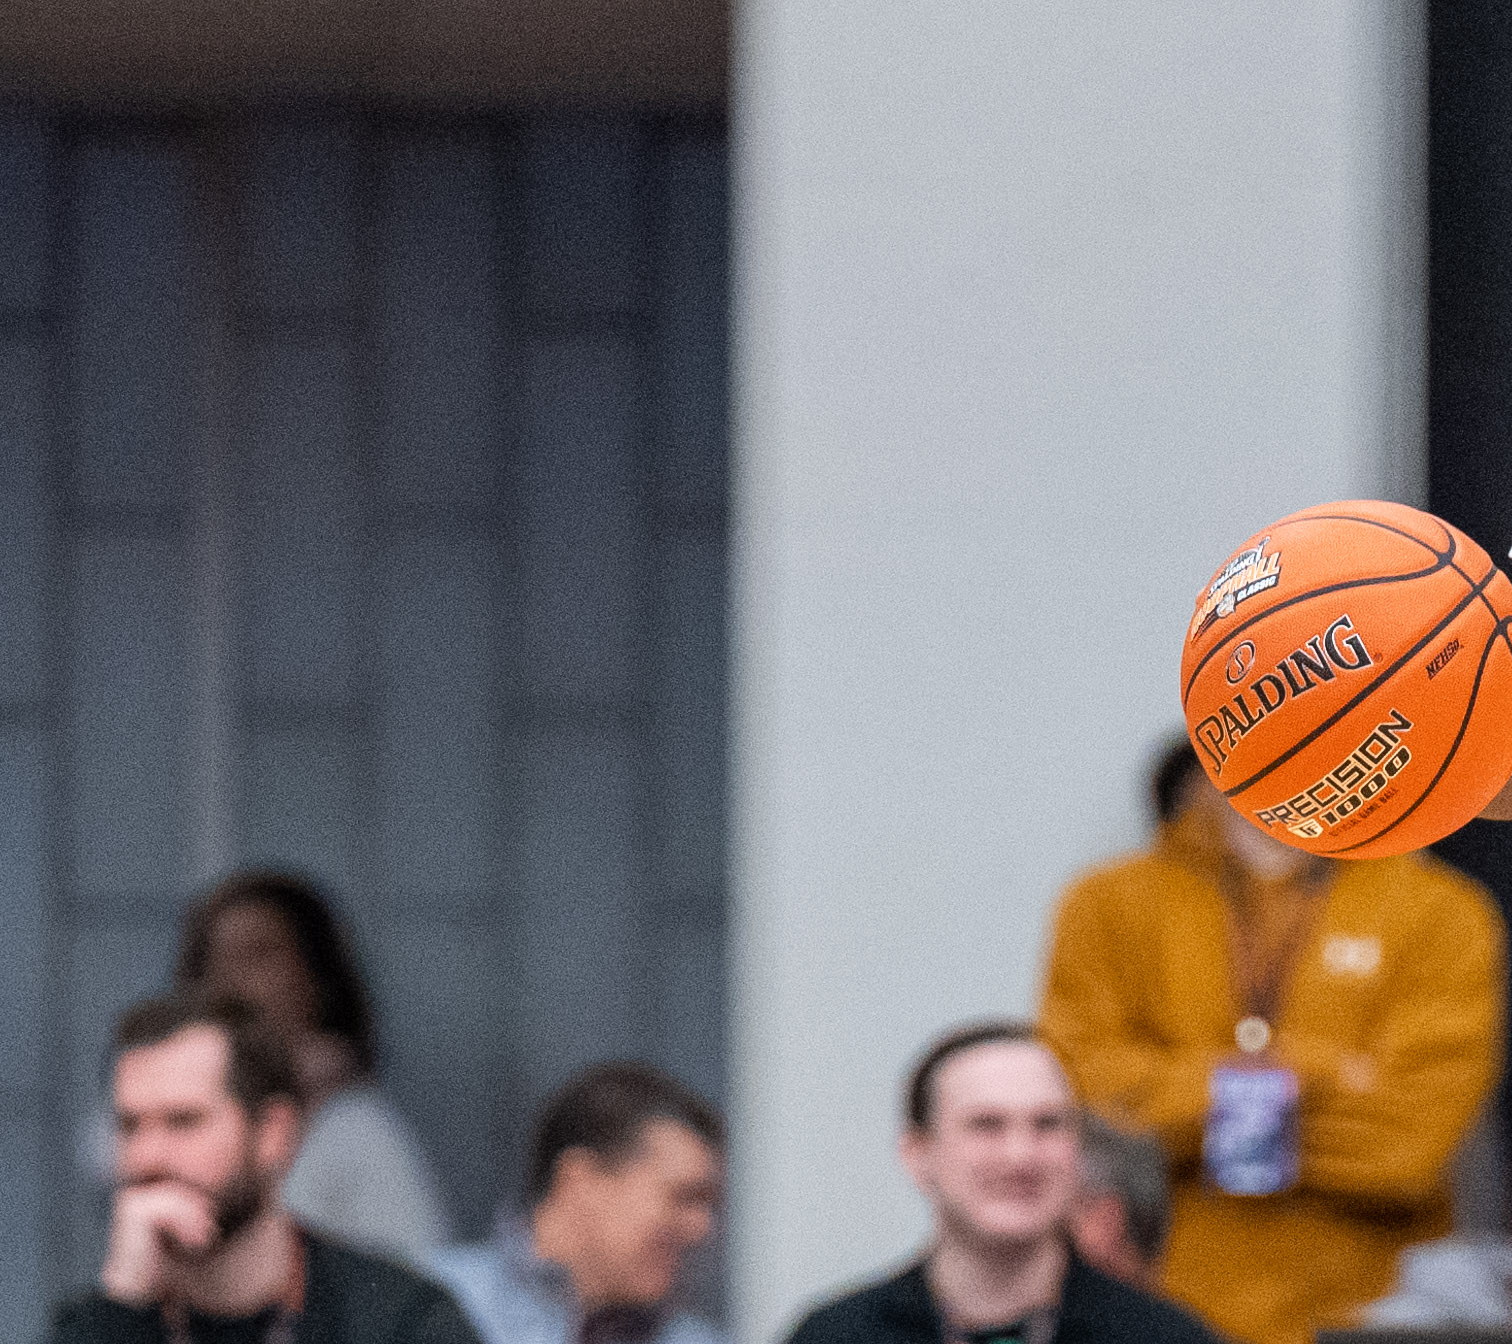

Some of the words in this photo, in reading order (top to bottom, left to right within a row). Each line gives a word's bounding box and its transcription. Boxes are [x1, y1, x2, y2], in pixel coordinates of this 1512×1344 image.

[1194, 613, 1374, 778] SPALDING
[1254, 707, 1415, 828] PRECISION
[1319, 745, 1412, 827] 1000
